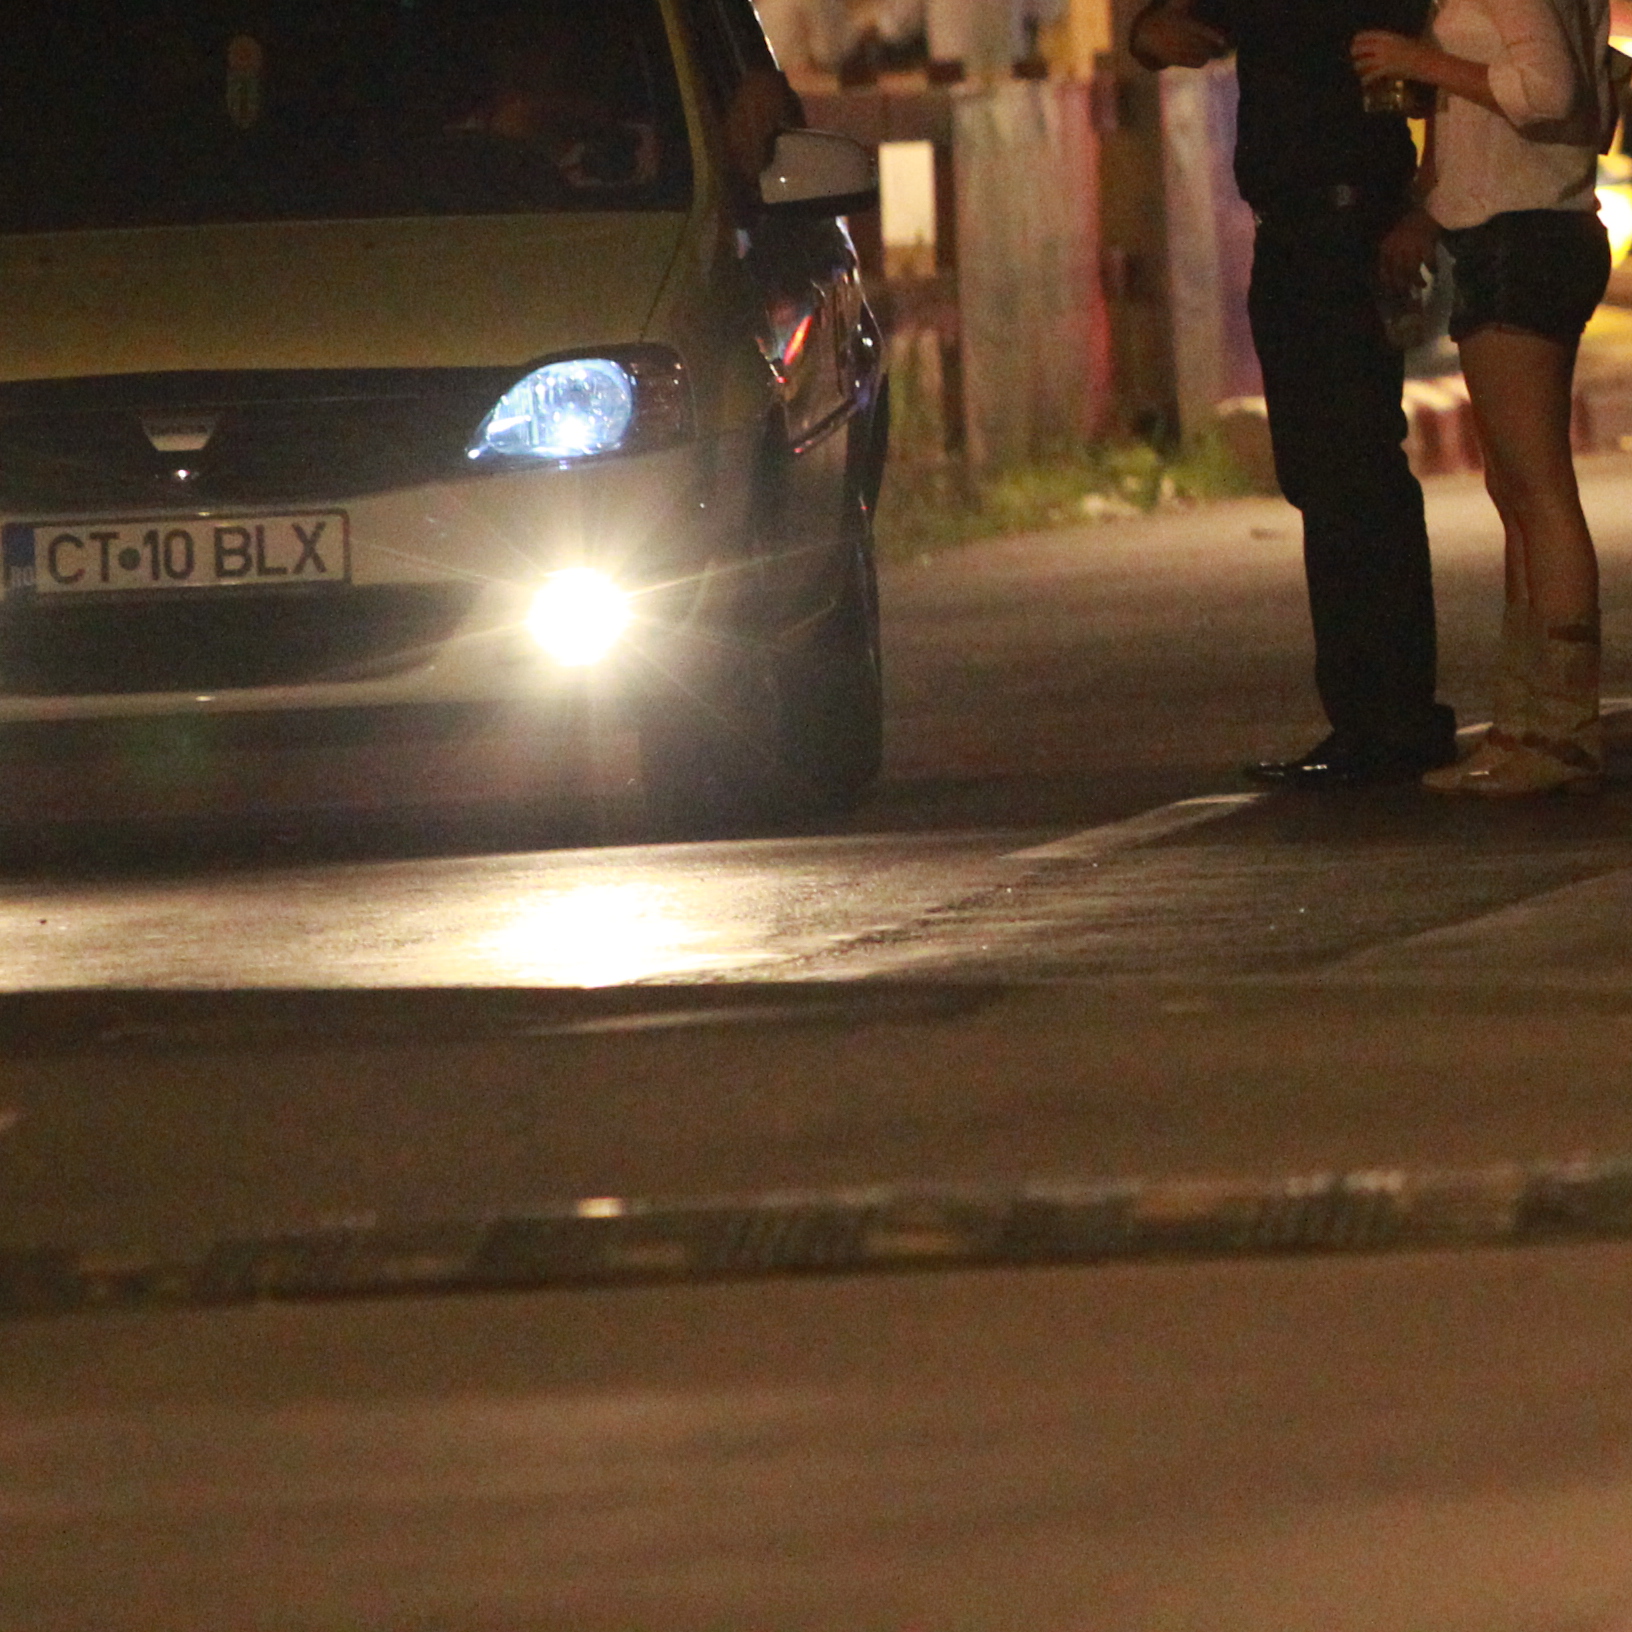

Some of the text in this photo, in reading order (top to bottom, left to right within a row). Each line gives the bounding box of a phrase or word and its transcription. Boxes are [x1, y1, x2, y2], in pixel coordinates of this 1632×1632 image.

[49, 521, 327, 585] CT 10 BLX
